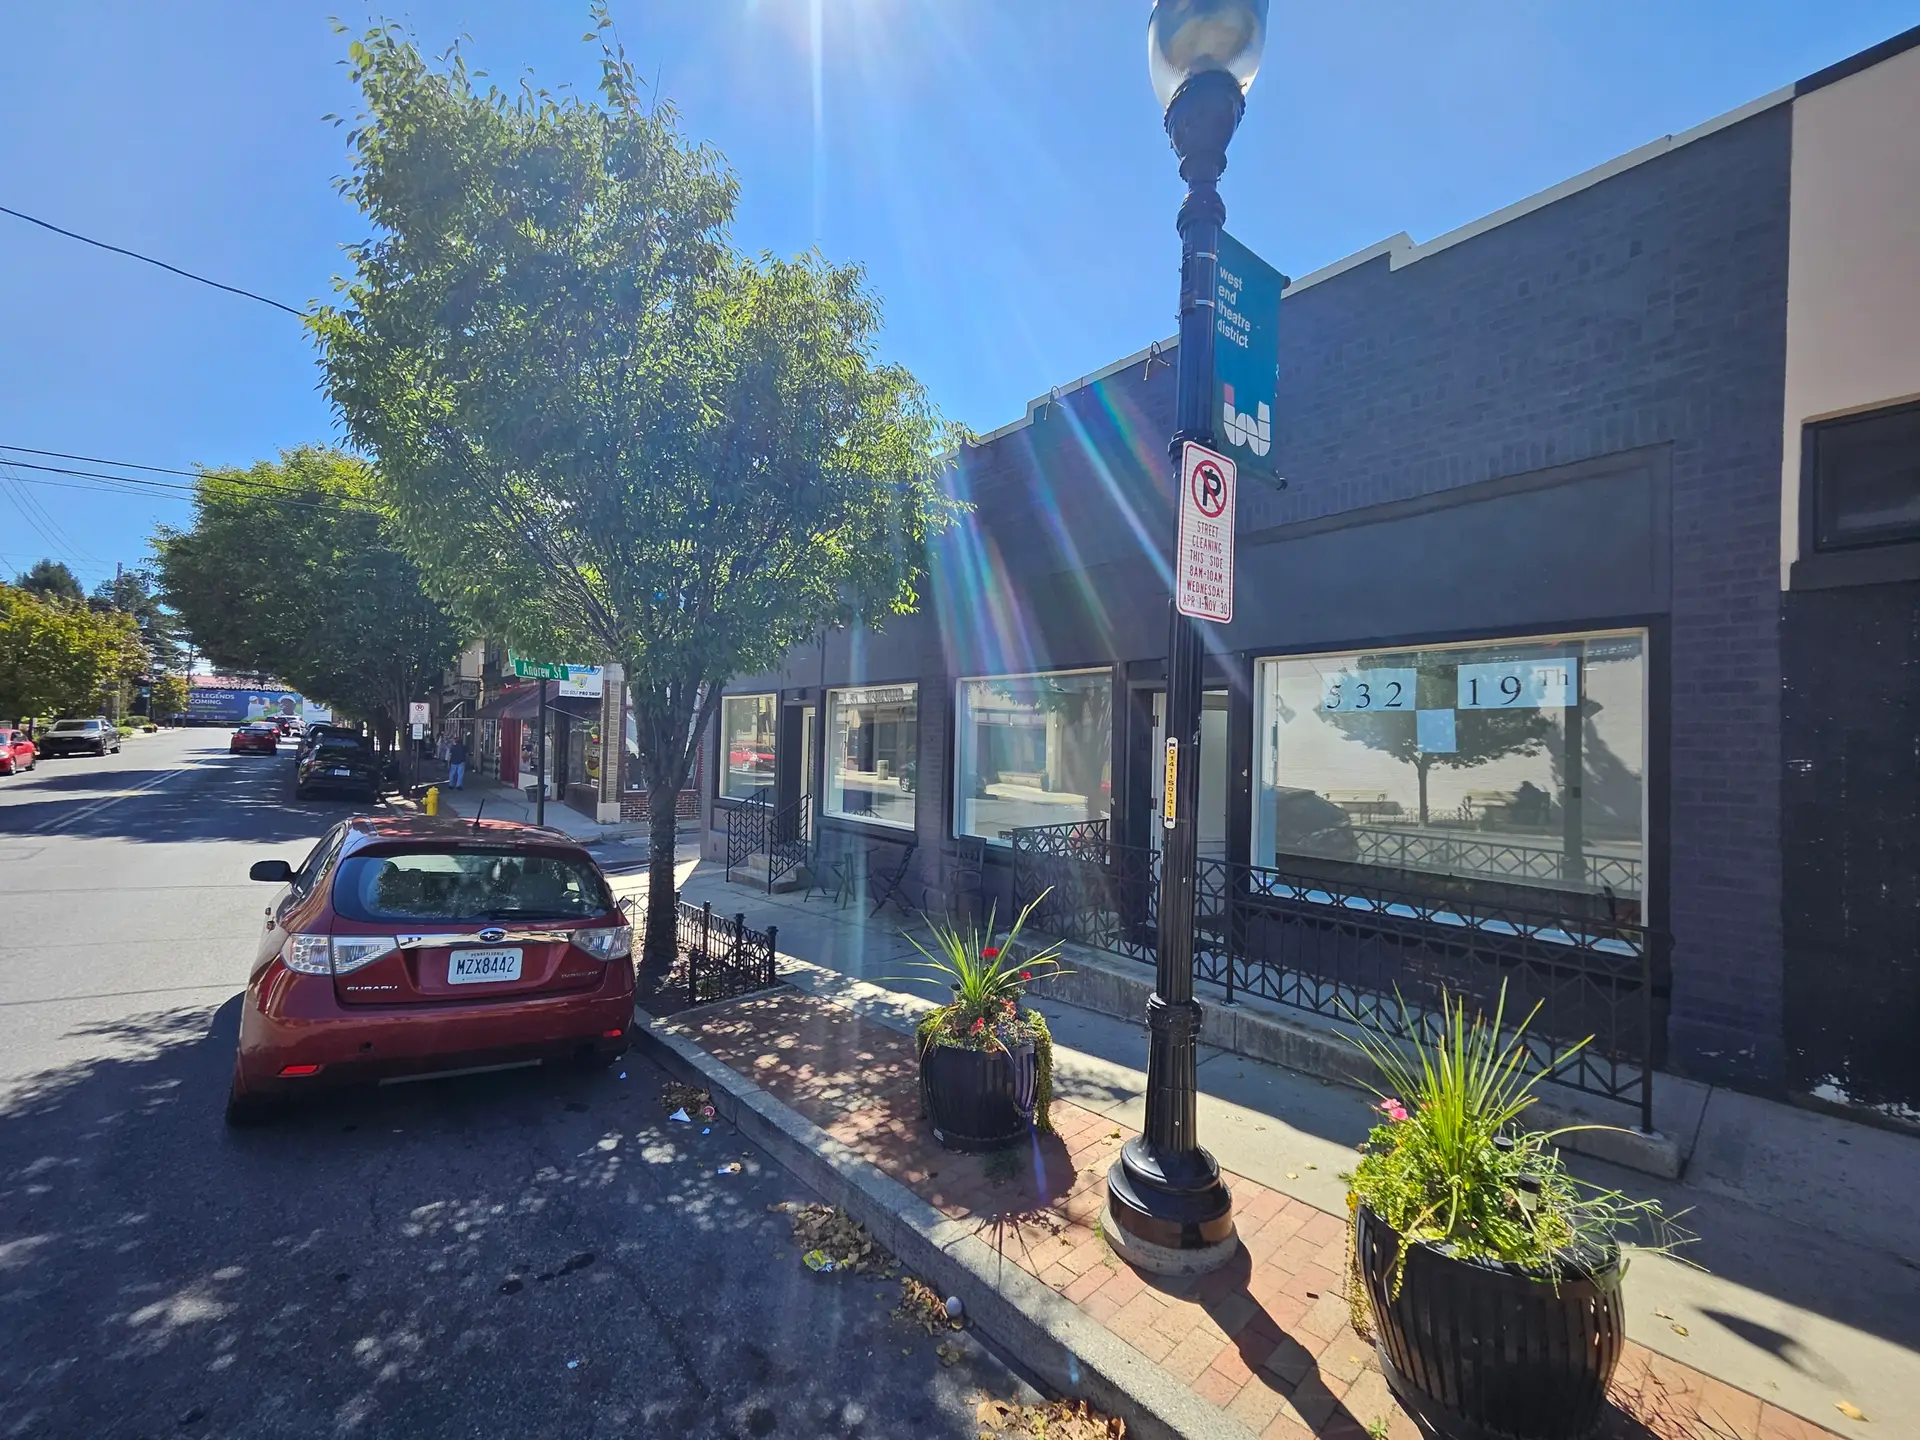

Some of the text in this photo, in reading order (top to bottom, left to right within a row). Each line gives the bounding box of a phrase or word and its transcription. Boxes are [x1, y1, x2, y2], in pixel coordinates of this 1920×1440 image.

[1219, 266, 1243, 291] west
[1218, 285, 1237, 306] end
[1218, 300, 1251, 332] theatre
[1217, 319, 1249, 348] district
[1197, 521, 1219, 538] STREET
[1192, 535, 1222, 554] CLEANING
[1190, 550, 1223, 569] THIS SIDE
[1189, 565, 1223, 584] 8AM-10AM
[1187, 578, 1225, 599] WEDNESDAY
[1183, 594, 1195, 607] APR
[1220, 602, 1228, 615] 30
[523, 661, 550, 679] Andrew
[553, 665, 563, 679] St
[201, 692, 235, 700] LEGENDS
[456, 956, 515, 975] MZX8442
